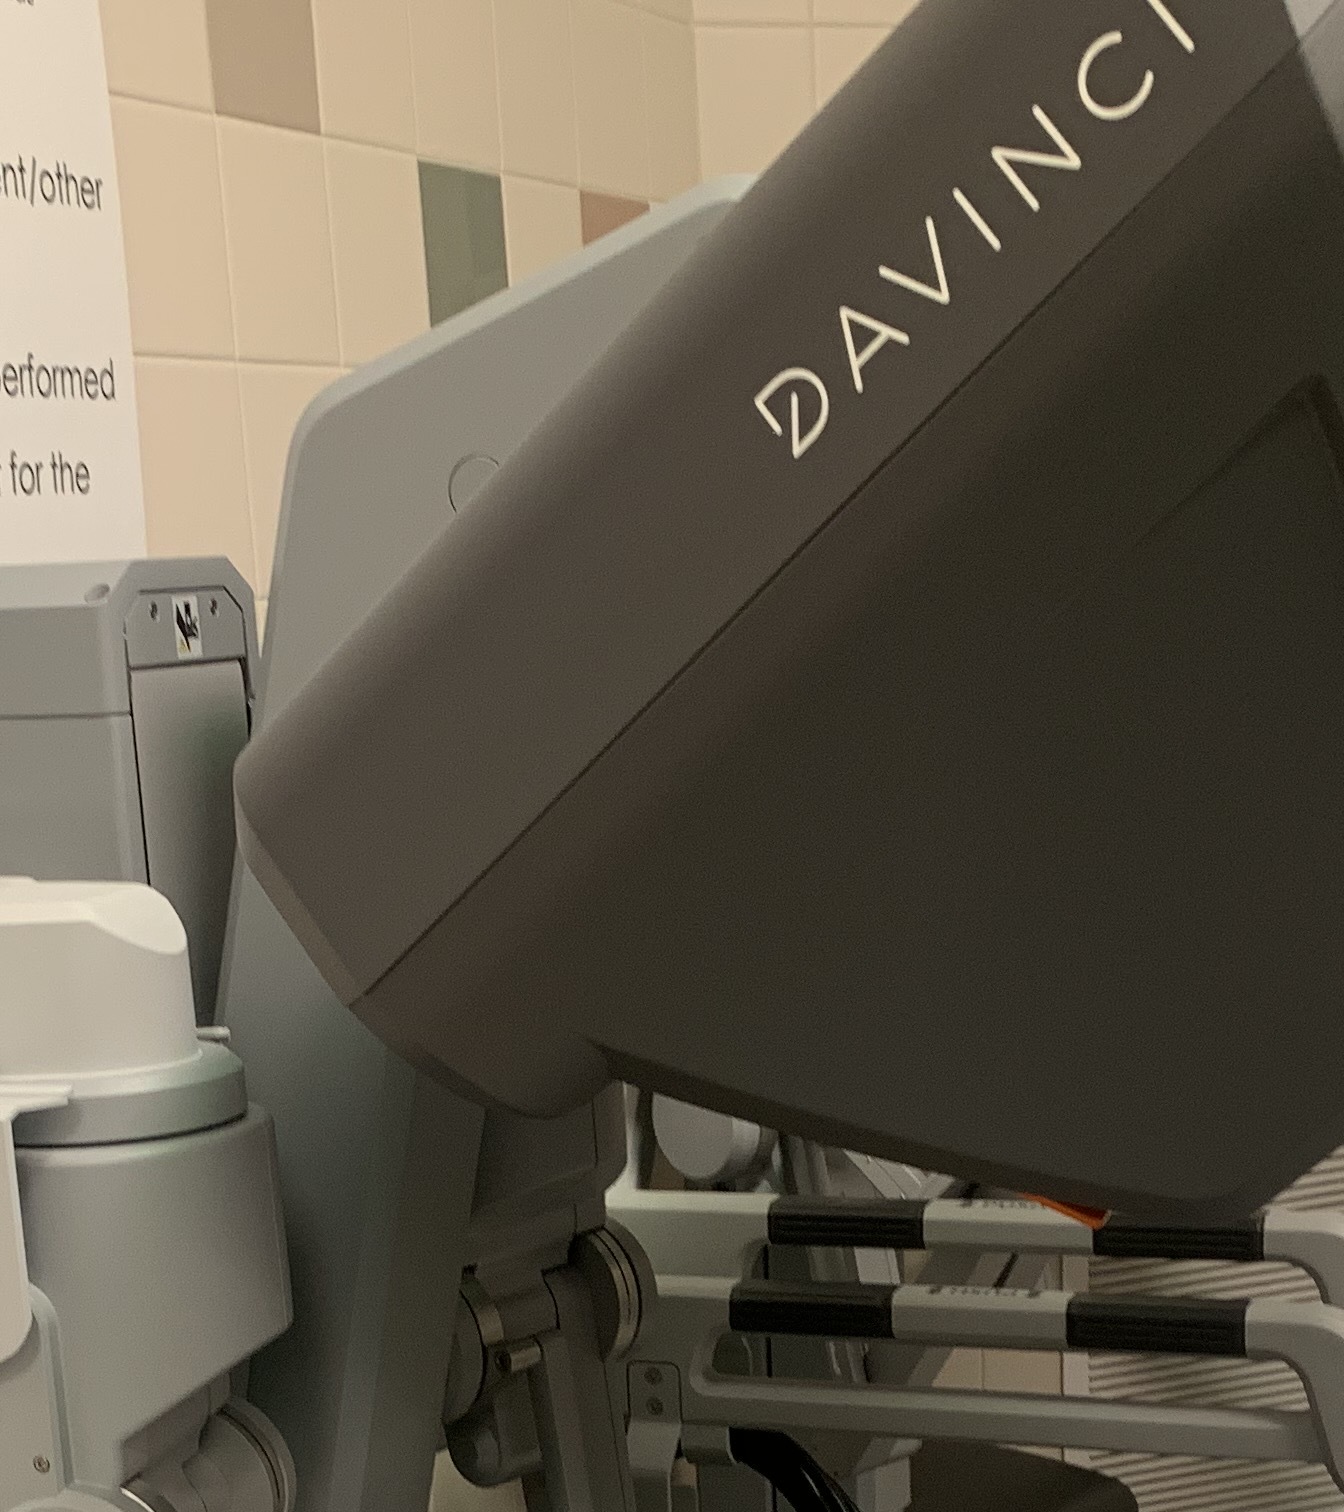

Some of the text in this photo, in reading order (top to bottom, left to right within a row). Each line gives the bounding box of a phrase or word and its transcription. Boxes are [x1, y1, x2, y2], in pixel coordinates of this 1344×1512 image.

[755, 0, 1194, 460] DAVINCI
[9, 450, 44, 497] for
[49, 451, 91, 496] the
